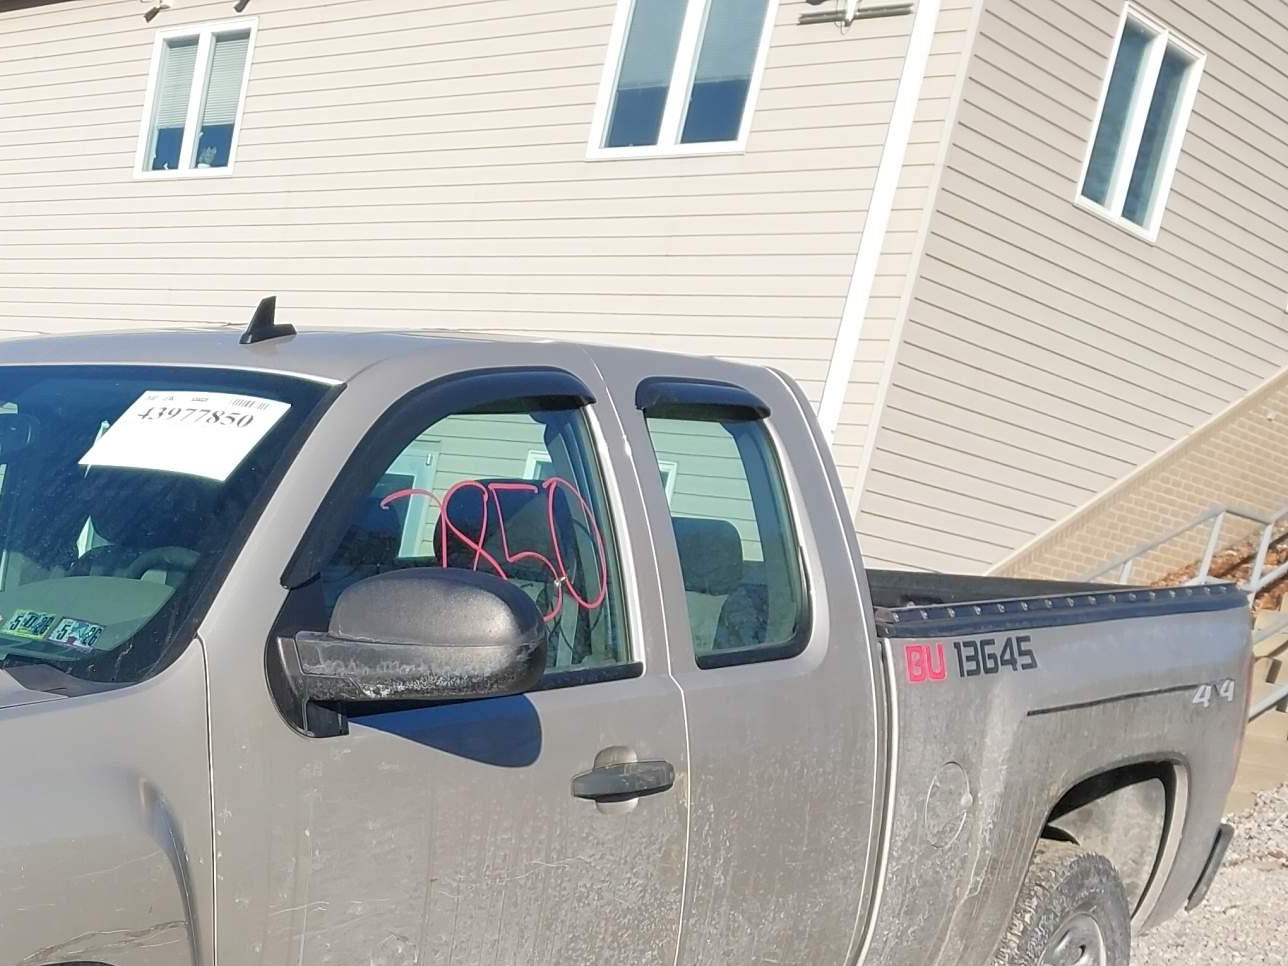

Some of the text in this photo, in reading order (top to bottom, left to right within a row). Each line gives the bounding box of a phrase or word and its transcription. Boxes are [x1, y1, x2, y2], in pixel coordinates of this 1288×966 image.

[138, 406, 255, 429] 43977850
[904, 634, 1039, 684] BU 13645
